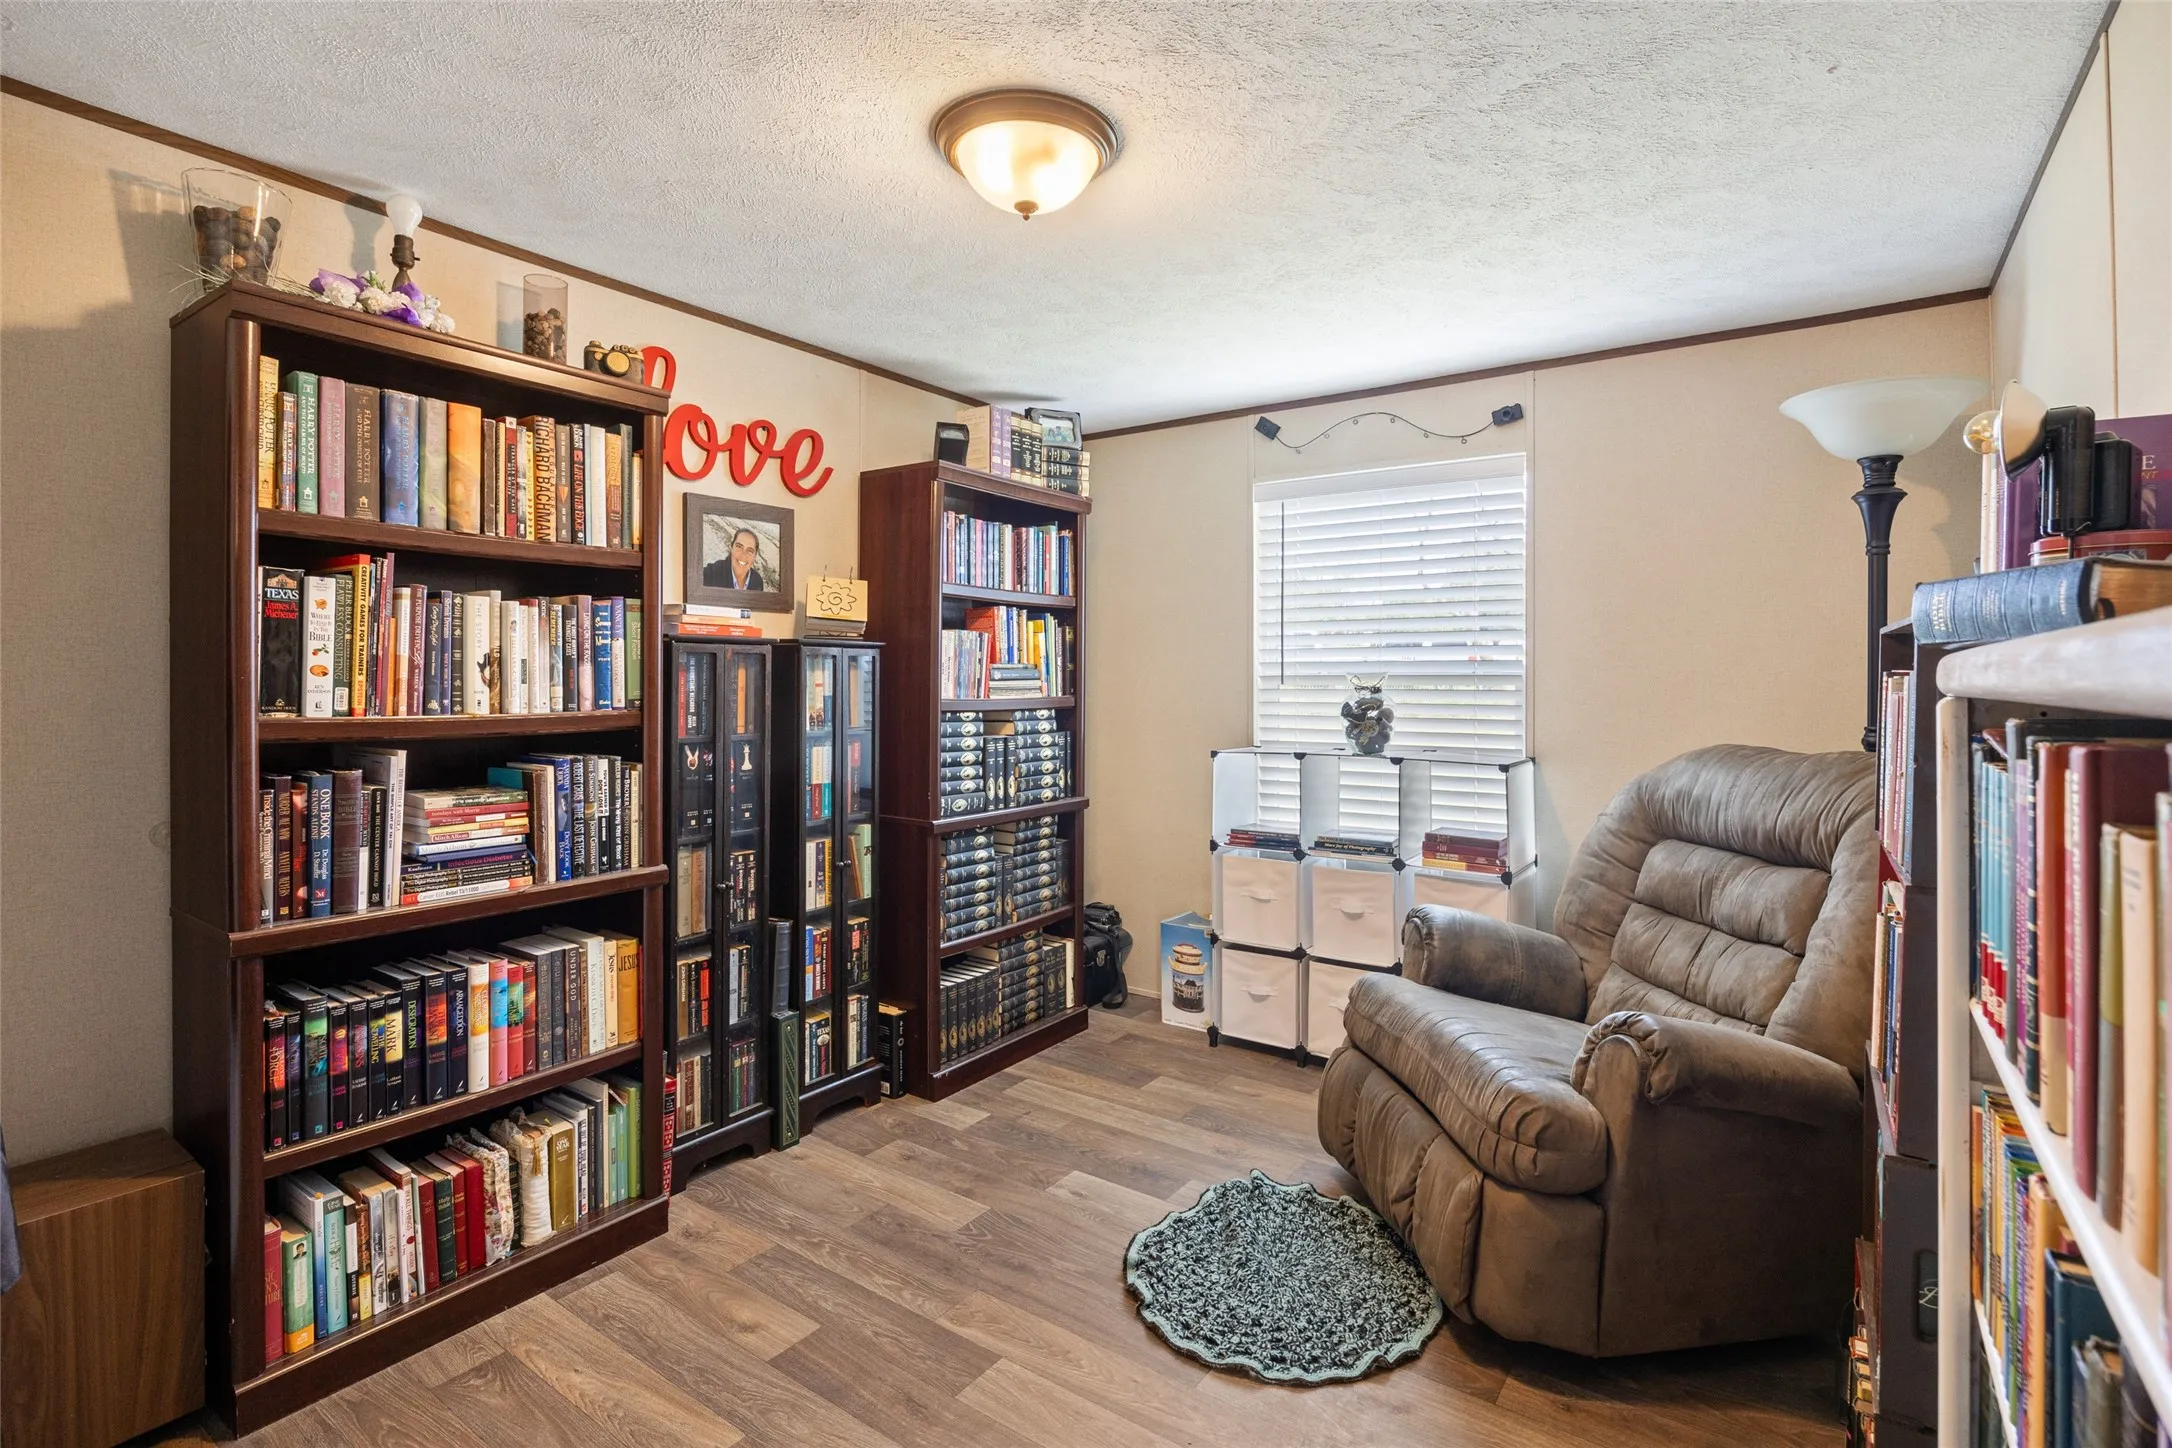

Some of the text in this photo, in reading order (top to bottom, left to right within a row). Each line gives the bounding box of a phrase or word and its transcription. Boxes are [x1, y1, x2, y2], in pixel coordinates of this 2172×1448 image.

[307, 396, 316, 474] HARRY POTTER
[363, 408, 372, 484] HARRY POTTER
[535, 416, 551, 542] RICHARD BACHMAN
[573, 463, 584, 532] LIFE ON THE EDGE
[264, 588, 299, 601] TEXAS
[360, 565, 368, 602] CREATIVITY
[264, 609, 299, 619] Michener
[265, 601, 290, 611] James
[344, 579, 353, 634] PETER BLOCK
[443, 597, 452, 639] Shrink Dreams
[309, 631, 333, 643] BIBLE
[334, 578, 345, 680] FLAWLESS CONSULTING
[573, 761, 584, 801] ROBERT CRAIS
[588, 772, 596, 802] SUMMONS
[311, 789, 319, 840] STANDS ALONE
[319, 788, 332, 839] ONE BOOK
[263, 794, 273, 880] Inside the Criminal Mind
[434, 832, 469, 842] Mitch Albom
[574, 808, 584, 865] THE LAST DETECTIVE
[588, 820, 597, 865] JOHN GRISHAM
[313, 858, 321, 879] Stauffer
[320, 849, 329, 880] Dr. Douglas
[447, 859, 483, 868] Infectious
[569, 950, 577, 1001] UNDER GOD
[407, 1000, 418, 1049] DESECRATION
[455, 989, 464, 1037] ARMAGEDDON
[386, 1018, 397, 1053] MARK
[269, 1047, 280, 1084] FORCE
